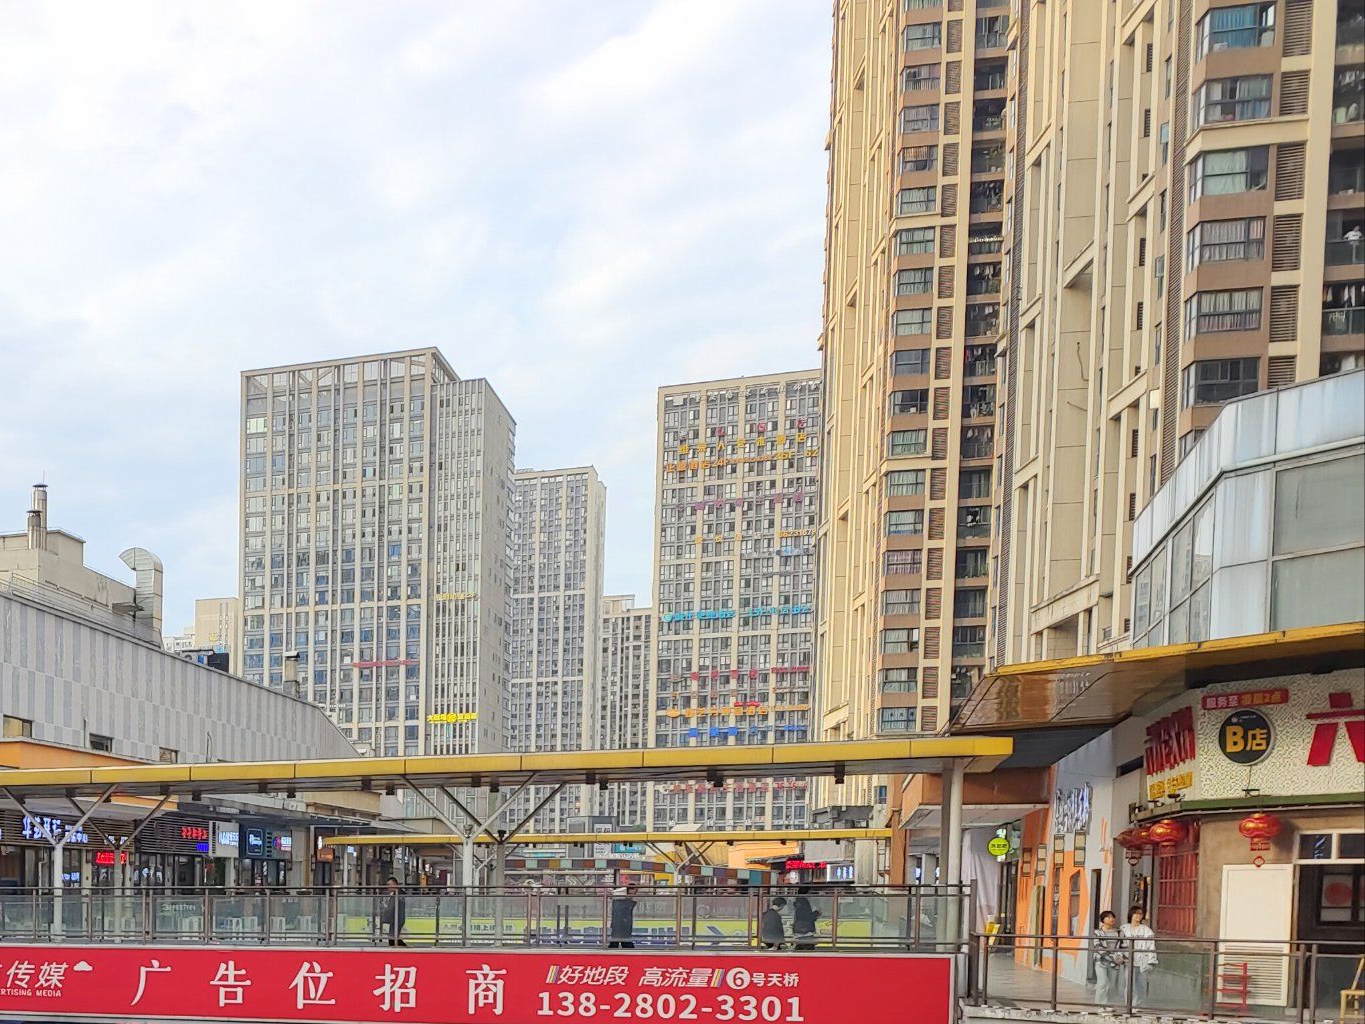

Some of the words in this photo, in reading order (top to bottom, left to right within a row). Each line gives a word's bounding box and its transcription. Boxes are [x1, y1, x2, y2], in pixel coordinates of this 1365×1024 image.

[1225, 725, 1267, 753] B店
[130, 959, 507, 1017] 广告位招商
[558, 965, 629, 987] 好地段
[638, 967, 713, 987] 高流量
[726, 967, 799, 989] 6号天桥
[36, 989, 62, 997] MEDIA
[537, 991, 804, 1022] 138-2802-3301
